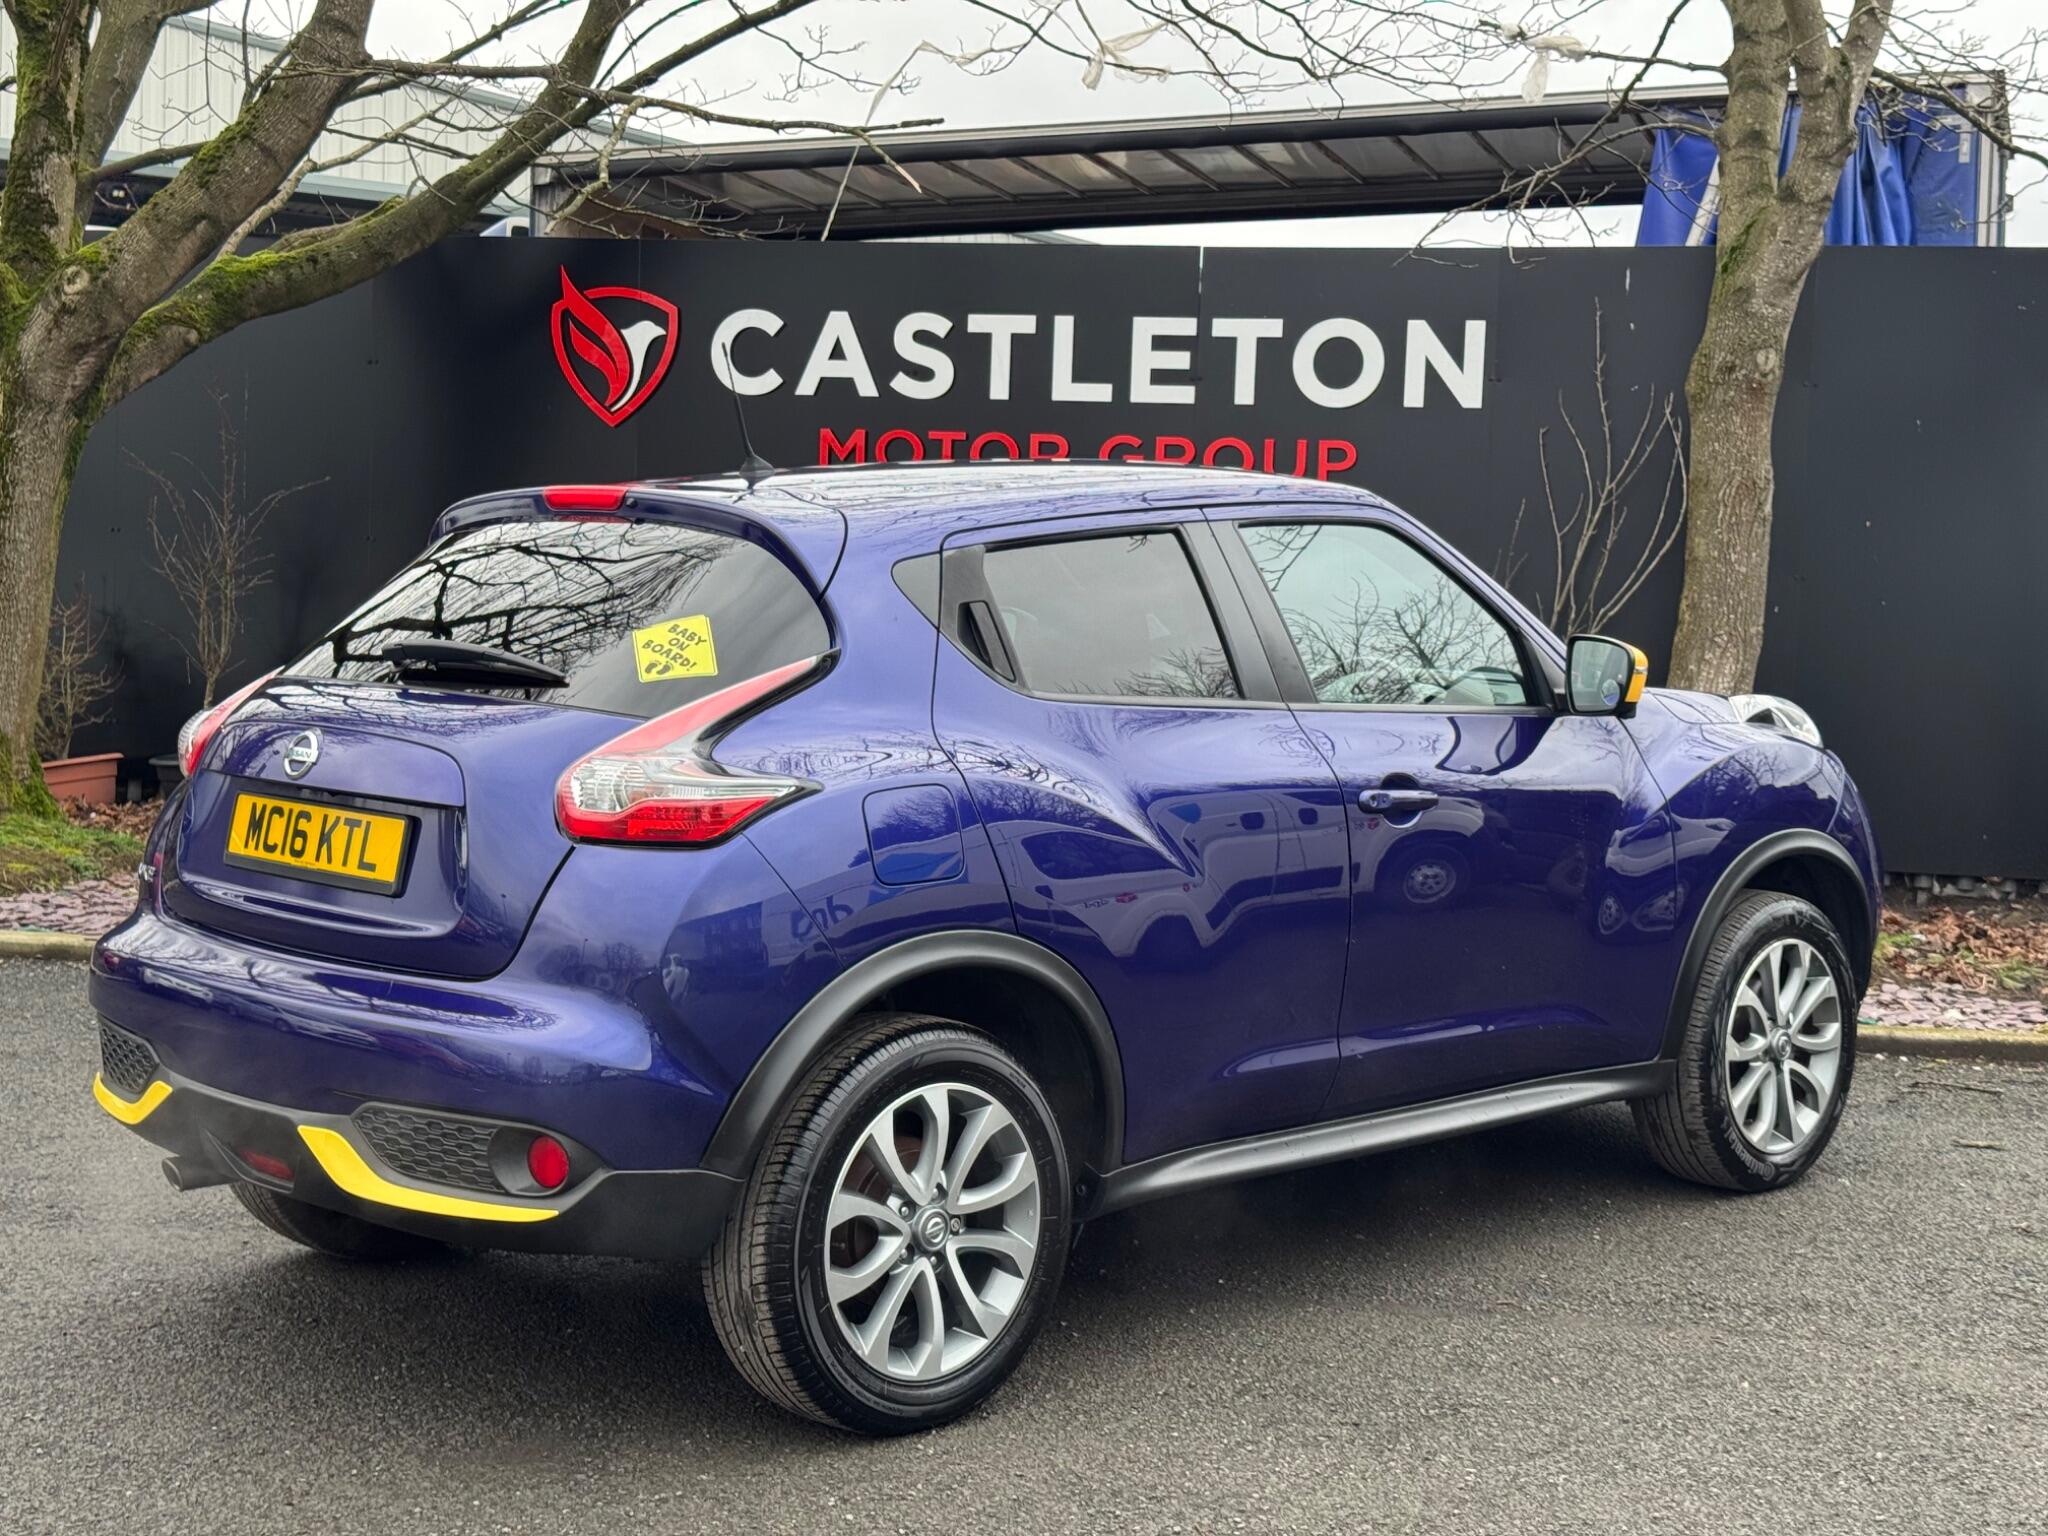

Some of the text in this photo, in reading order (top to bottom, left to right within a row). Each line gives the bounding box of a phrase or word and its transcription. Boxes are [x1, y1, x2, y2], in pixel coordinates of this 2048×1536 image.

[710, 308, 1487, 410] CASTLETON
[819, 427, 1357, 481] MOTOR GROUP
[641, 639, 697, 672] BOARD!
[667, 623, 707, 646] BABY
[668, 637, 690, 651] ON
[244, 801, 377, 872] MC16 KTL
